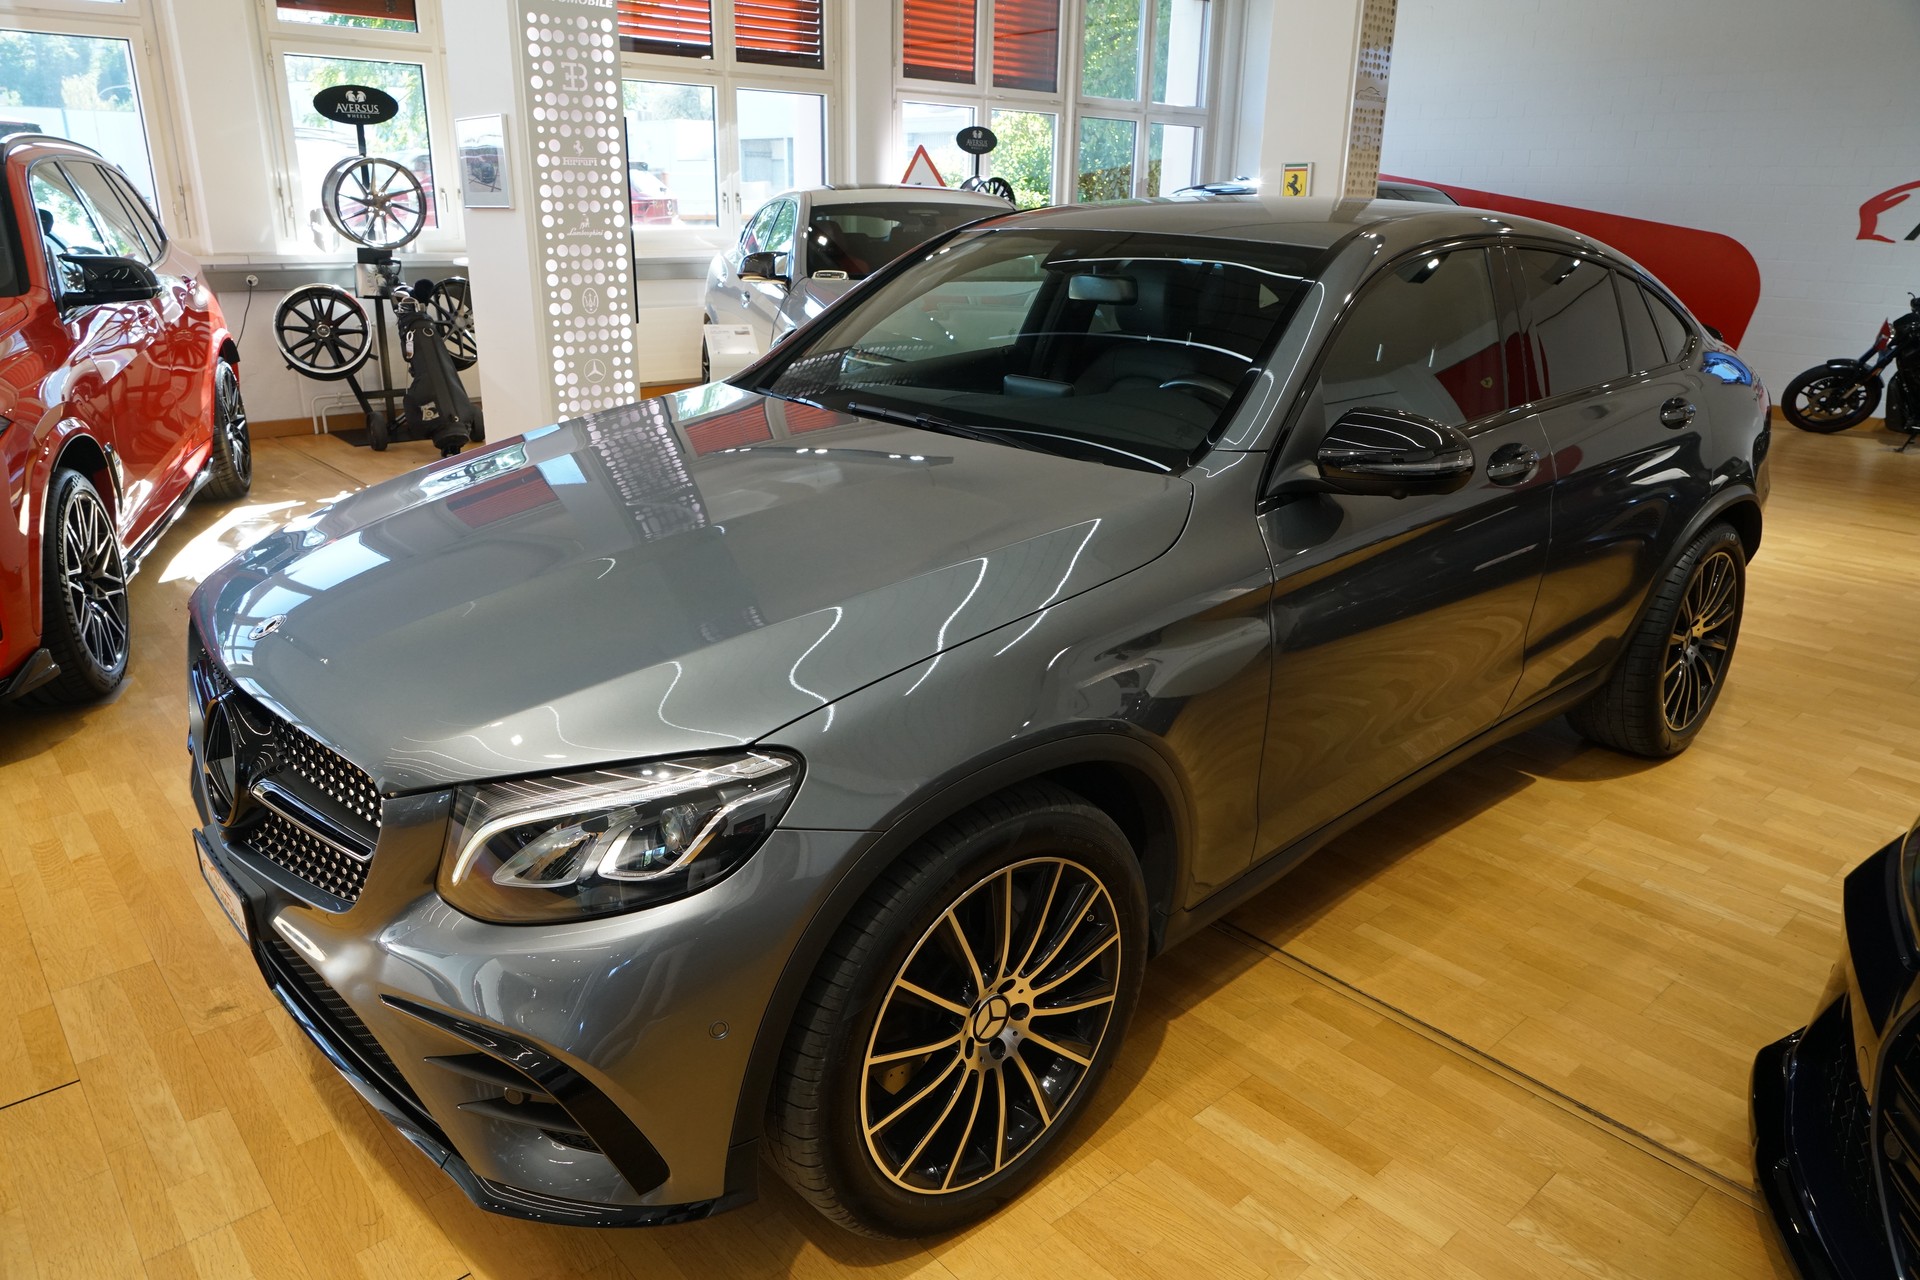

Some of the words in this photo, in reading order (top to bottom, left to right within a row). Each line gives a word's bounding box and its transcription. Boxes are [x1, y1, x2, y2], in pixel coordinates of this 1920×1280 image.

[335, 103, 380, 114] AVERSUS
[562, 156, 598, 166] Ferrari
[567, 227, 604, 238] Lamborghini
